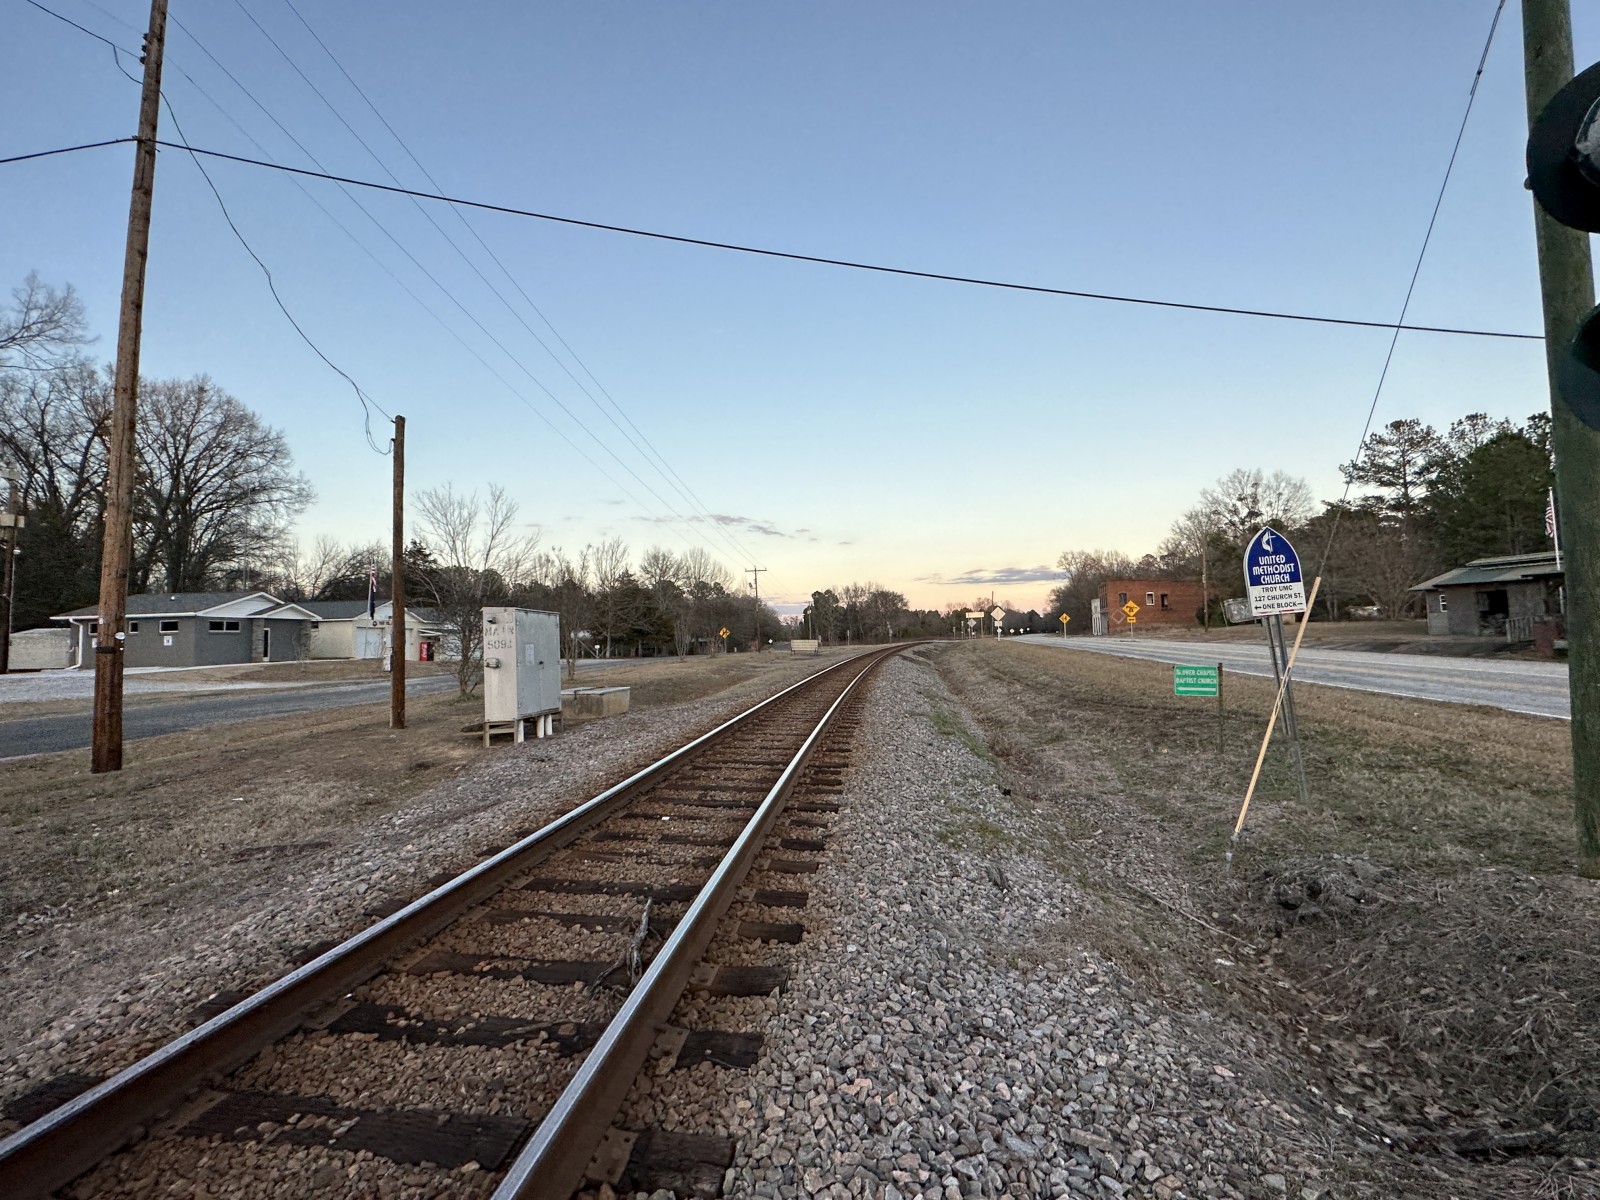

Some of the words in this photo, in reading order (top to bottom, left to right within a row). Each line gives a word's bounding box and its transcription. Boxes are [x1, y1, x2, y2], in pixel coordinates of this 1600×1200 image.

[1259, 555, 1285, 564] UNITED
[1253, 564, 1294, 575] METHODIST
[1261, 573, 1290, 584] CHURCH
